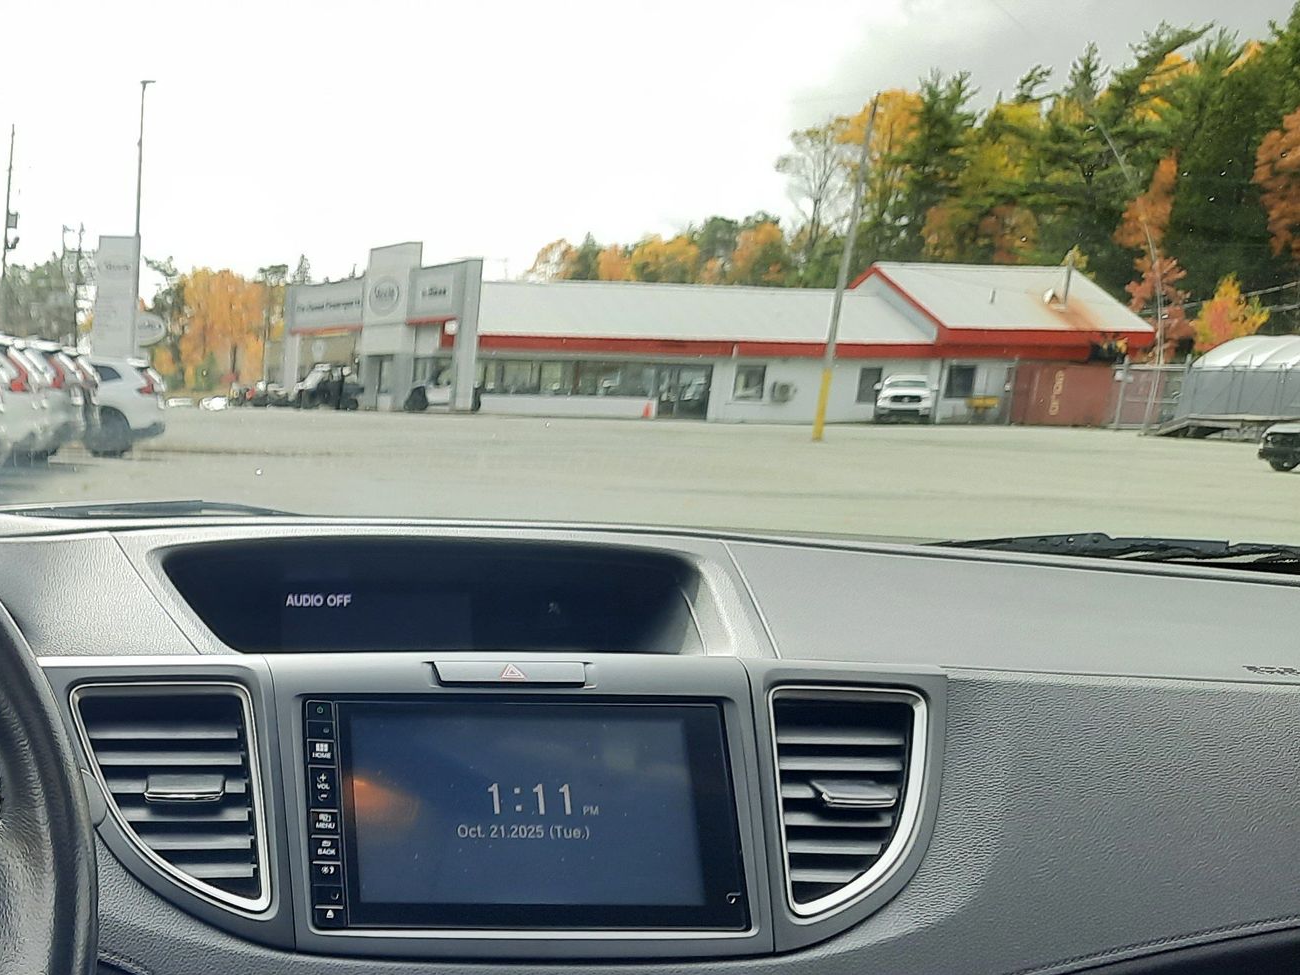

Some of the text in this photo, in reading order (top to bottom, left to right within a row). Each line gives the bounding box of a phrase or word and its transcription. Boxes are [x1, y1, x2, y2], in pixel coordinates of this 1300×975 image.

[286, 593, 352, 607] AUDIO OFF
[488, 783, 599, 816] 1:11 PM
[457, 824, 591, 840] Oct. 21.2025 (Tue.)
